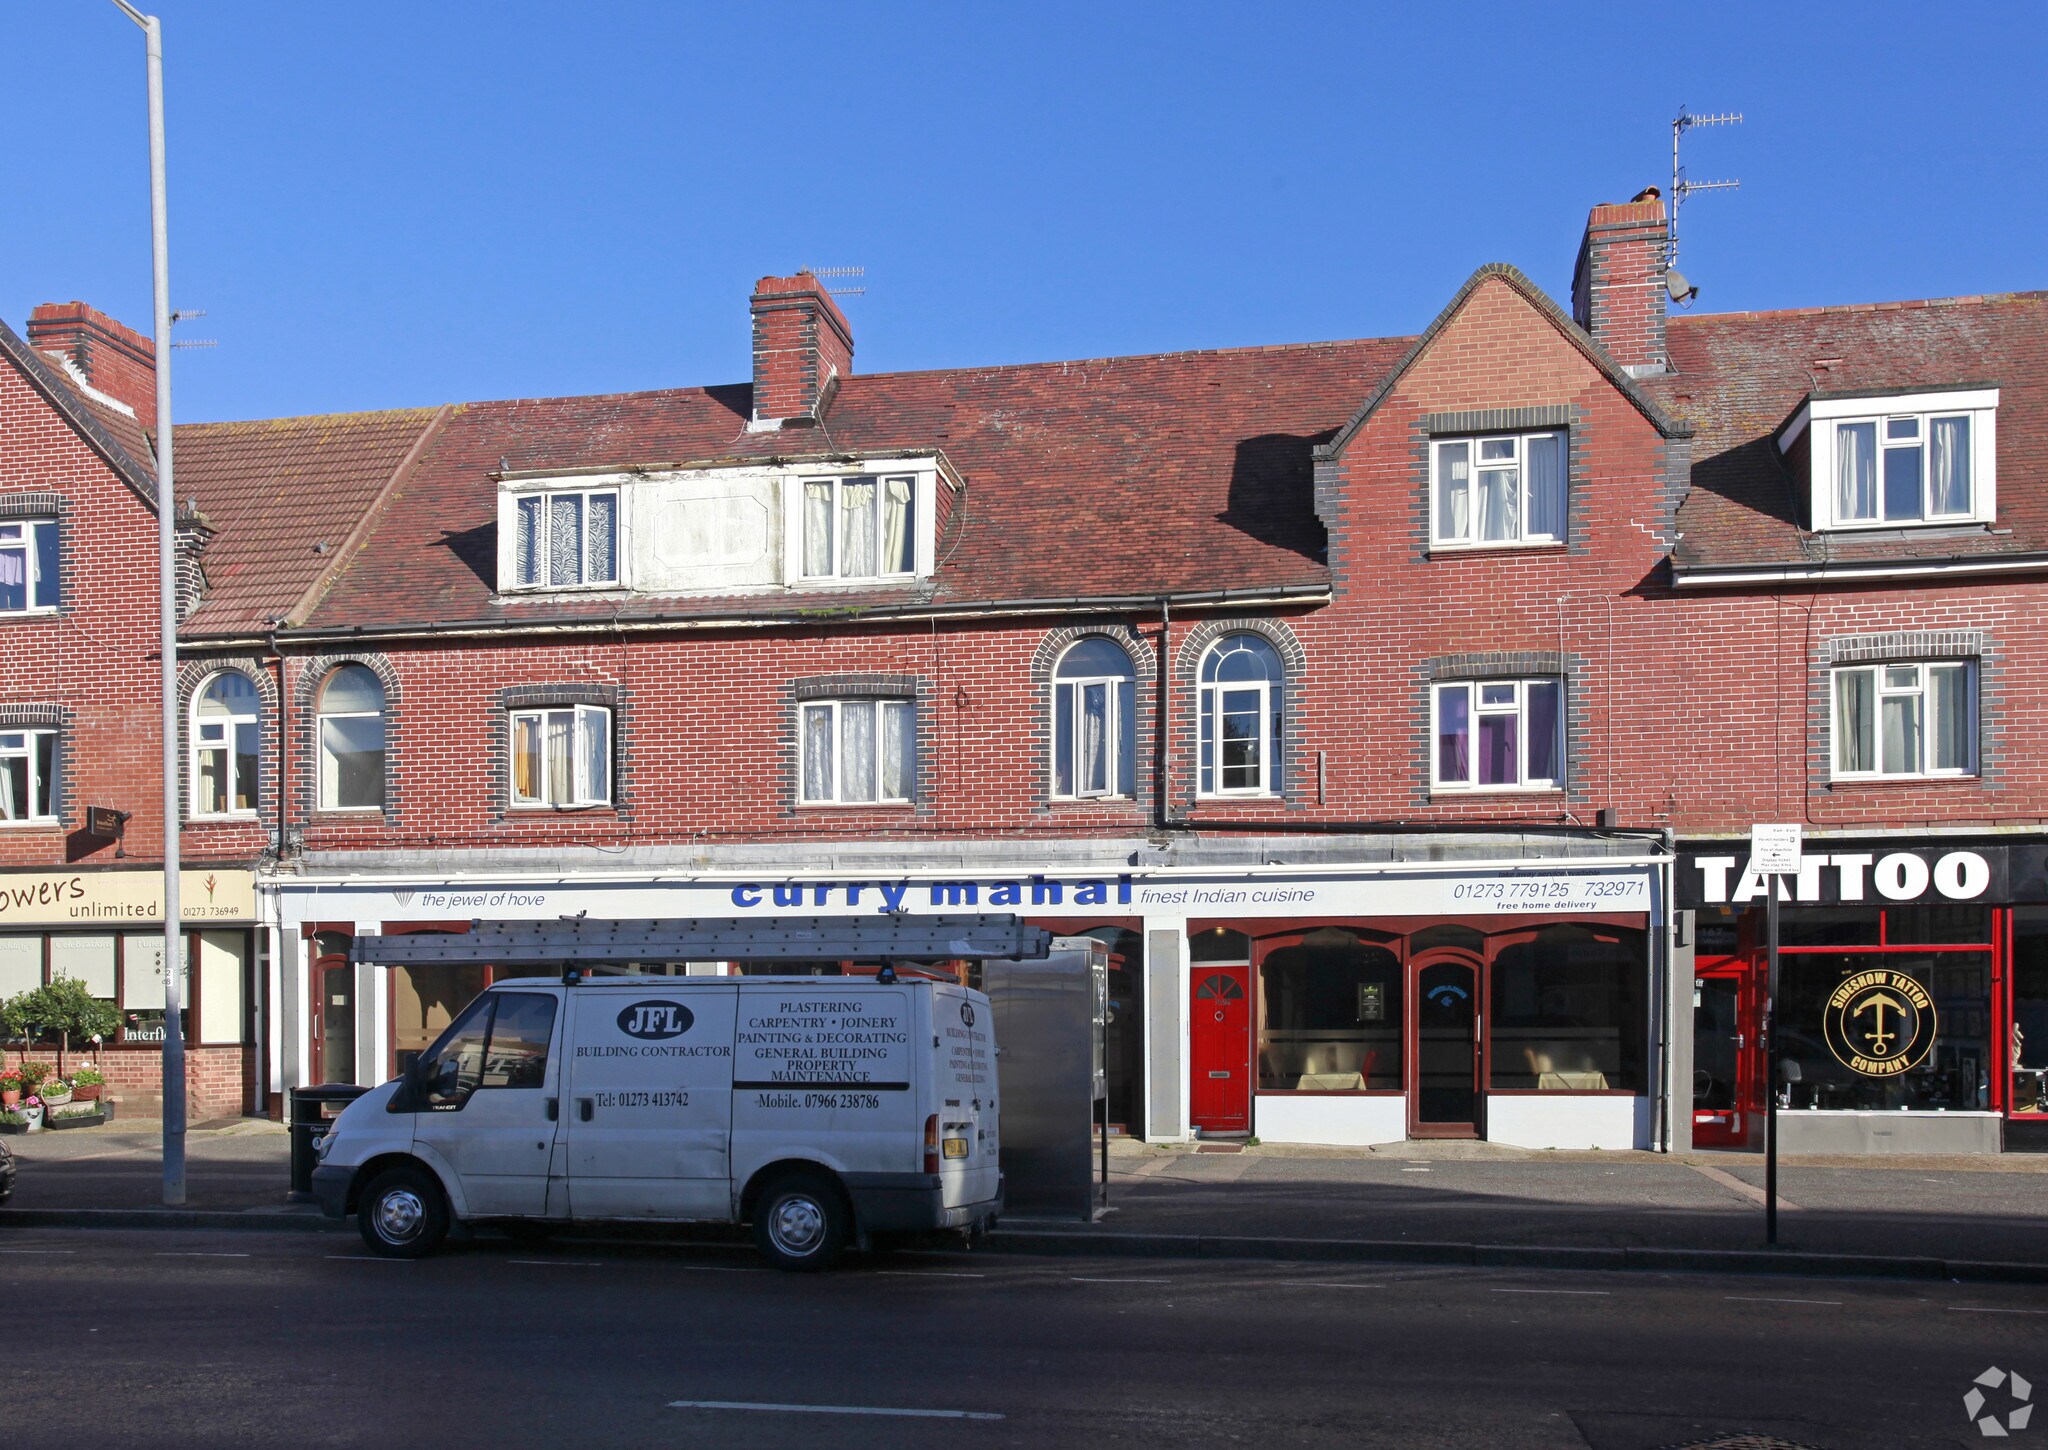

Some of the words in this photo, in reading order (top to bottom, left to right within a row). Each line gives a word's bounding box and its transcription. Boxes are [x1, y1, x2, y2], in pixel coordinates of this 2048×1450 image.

[1695, 851, 1990, 903] TATTOO
[731, 880, 910, 914] curry
[930, 873, 1132, 905] mahal
[1140, 889, 1189, 904] finest
[1192, 888, 1248, 903] Indian
[1251, 887, 1315, 902] cuisine
[1453, 884, 1505, 899] 01273
[1509, 883, 1570, 898] 779125
[1584, 881, 1645, 897] 732971
[422, 893, 446, 906] the
[446, 893, 488, 909] jewel
[489, 892, 507, 906] of
[507, 892, 545, 906] hove
[1554, 901, 1597, 910] delivery
[69, 901, 157, 917] unlimited
[183, 907, 206, 916] 01273
[210, 907, 239, 916] 736949
[55, 940, 112, 950] Celebrations
[1831, 972, 1887, 1009] SIDESHOW
[1891, 974, 1929, 1009] TATTOO
[779, 1002, 862, 1013] PLASTERING
[628, 1006, 682, 1033] JFL
[749, 1018, 827, 1028] CARPENTRY
[841, 1017, 897, 1030] JOINERY
[123, 1026, 185, 1041] Interfla
[737, 1033, 801, 1043] PAINTING
[804, 1035, 813, 1043] &
[816, 1033, 907, 1044] DECORATING
[576, 1046, 638, 1057] BUILDING
[641, 1046, 731, 1057] CONTRACTOR
[754, 1048, 817, 1059] GENERAL
[820, 1048, 887, 1059] BUILDING
[787, 1061, 857, 1071] PROPERTY
[1850, 1055, 1909, 1074] COMPANY
[771, 1071, 871, 1082] MAINTENANCE
[596, 1093, 615, 1107] Tel:
[619, 1092, 649, 1106] 01273
[652, 1092, 689, 1106] 413742
[805, 1094, 837, 1109] 07966
[840, 1094, 879, 1109] 238786
